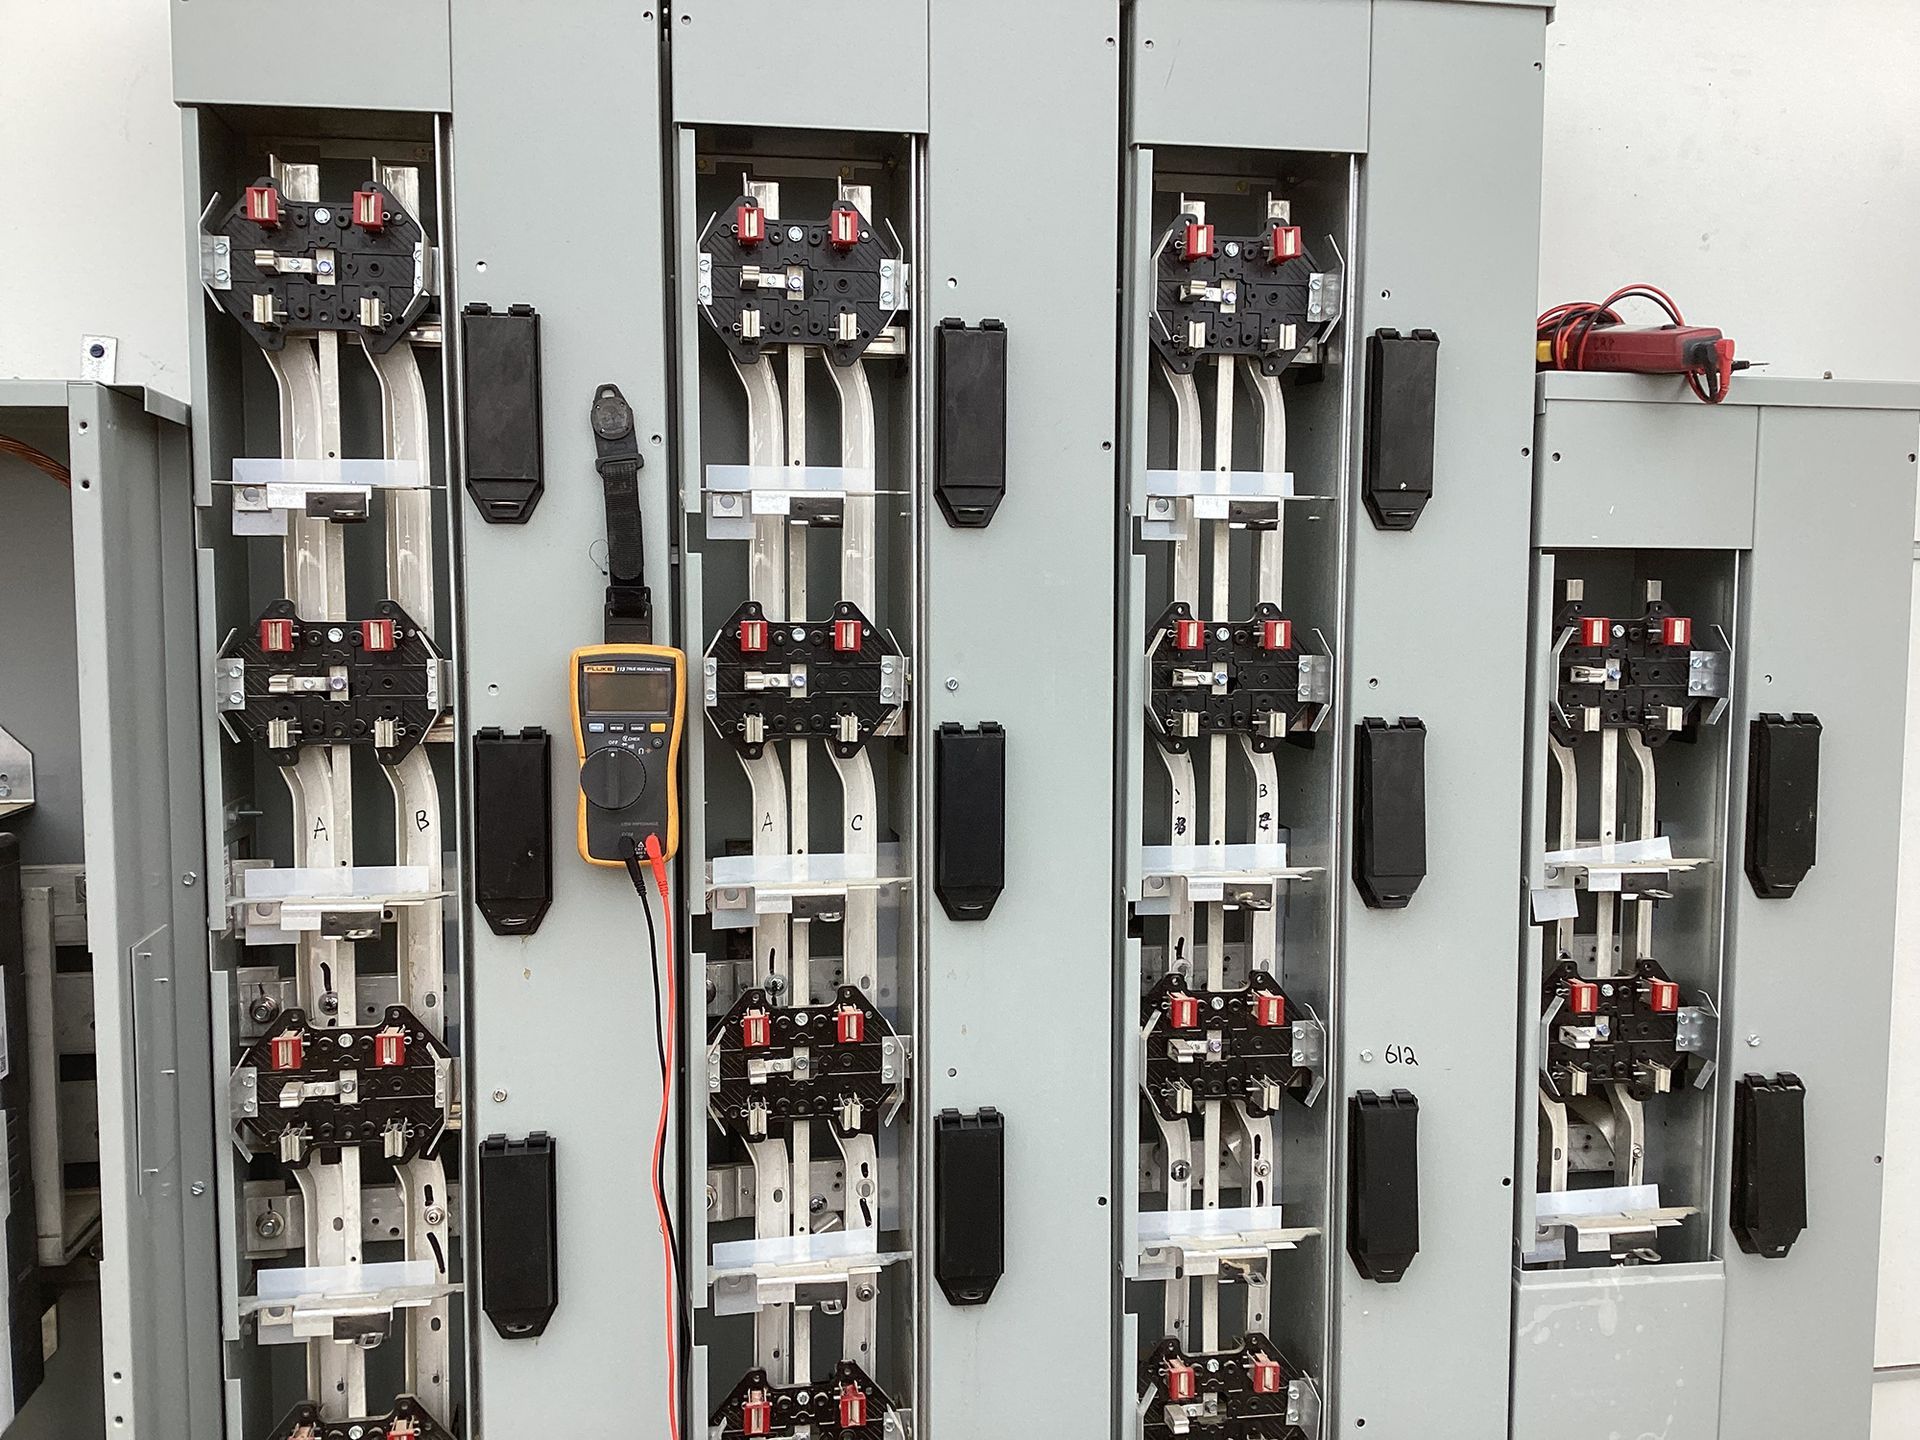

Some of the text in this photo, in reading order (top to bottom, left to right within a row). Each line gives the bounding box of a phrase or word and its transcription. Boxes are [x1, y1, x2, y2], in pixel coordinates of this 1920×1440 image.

[1259, 783, 1268, 798] B
[314, 817, 328, 841] A
[416, 809, 430, 832] B
[761, 812, 773, 832] A
[851, 814, 862, 831] C
[1385, 1044, 1419, 1066] 612
